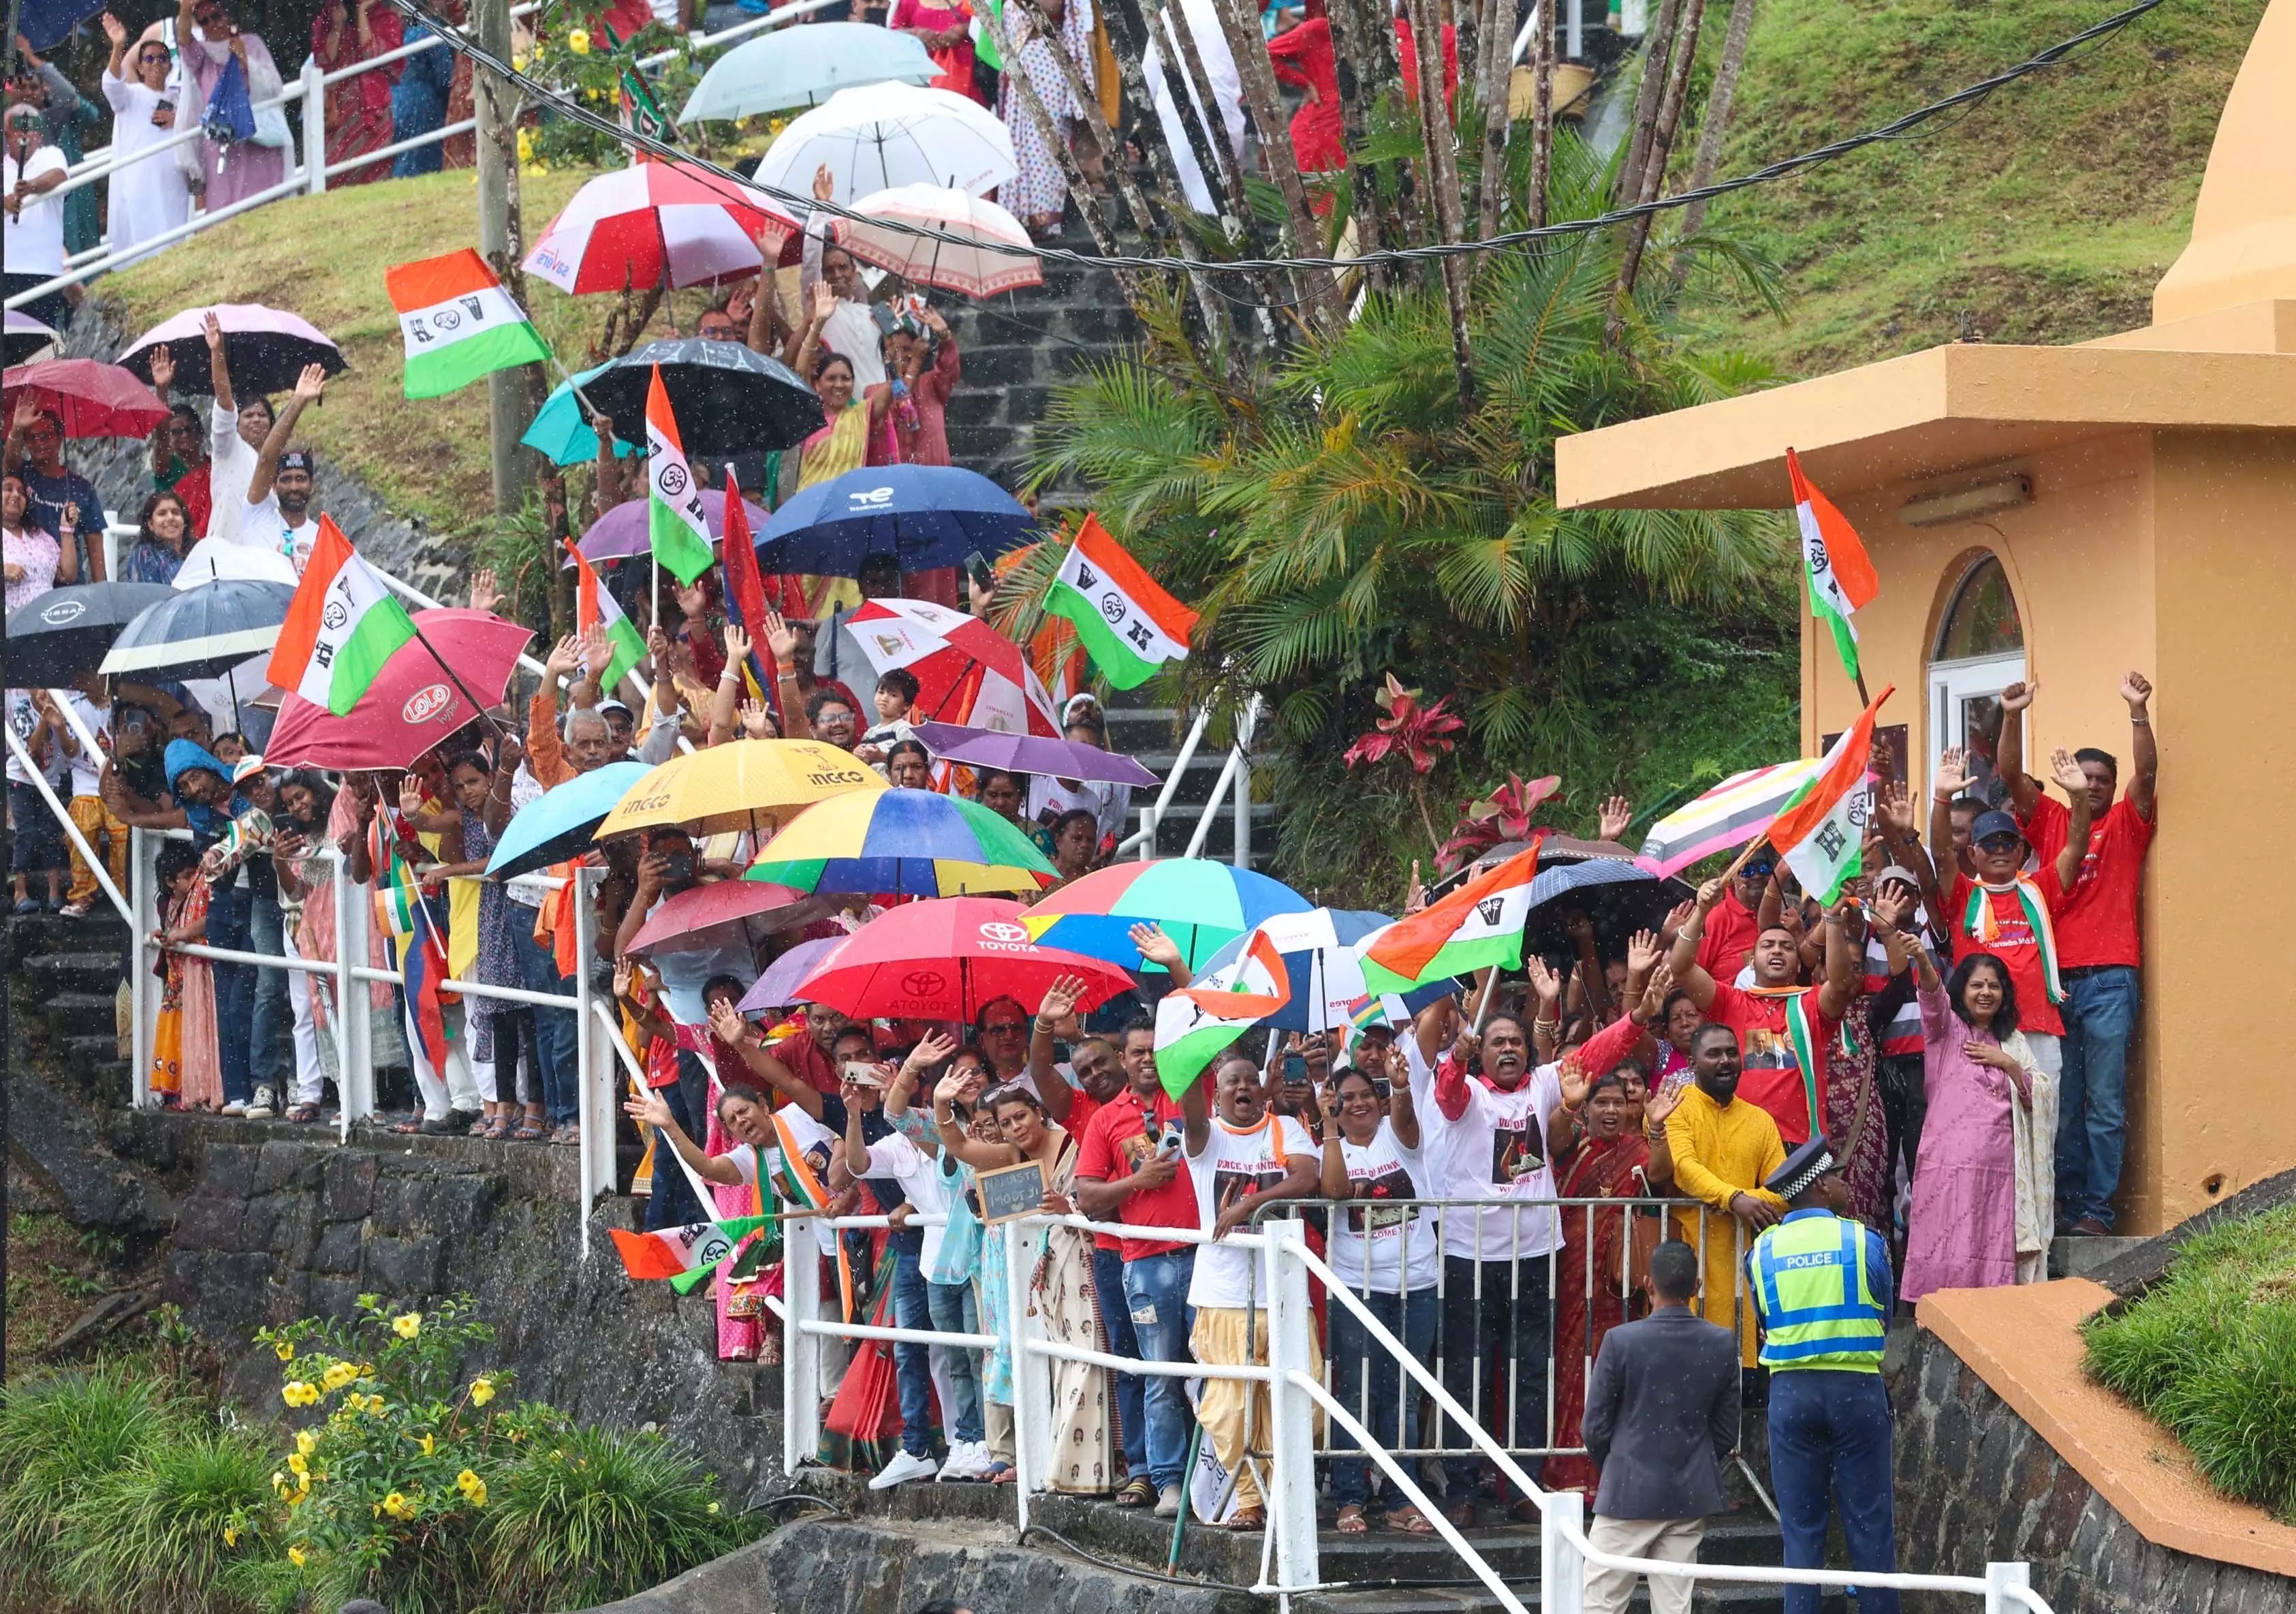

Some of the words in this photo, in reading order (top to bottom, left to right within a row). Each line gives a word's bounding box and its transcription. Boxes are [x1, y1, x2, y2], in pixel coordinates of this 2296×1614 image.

[41, 606, 86, 619] NISSAN
[976, 941, 1041, 954] TOYOTA
[1787, 1252, 1831, 1269] POLICE
